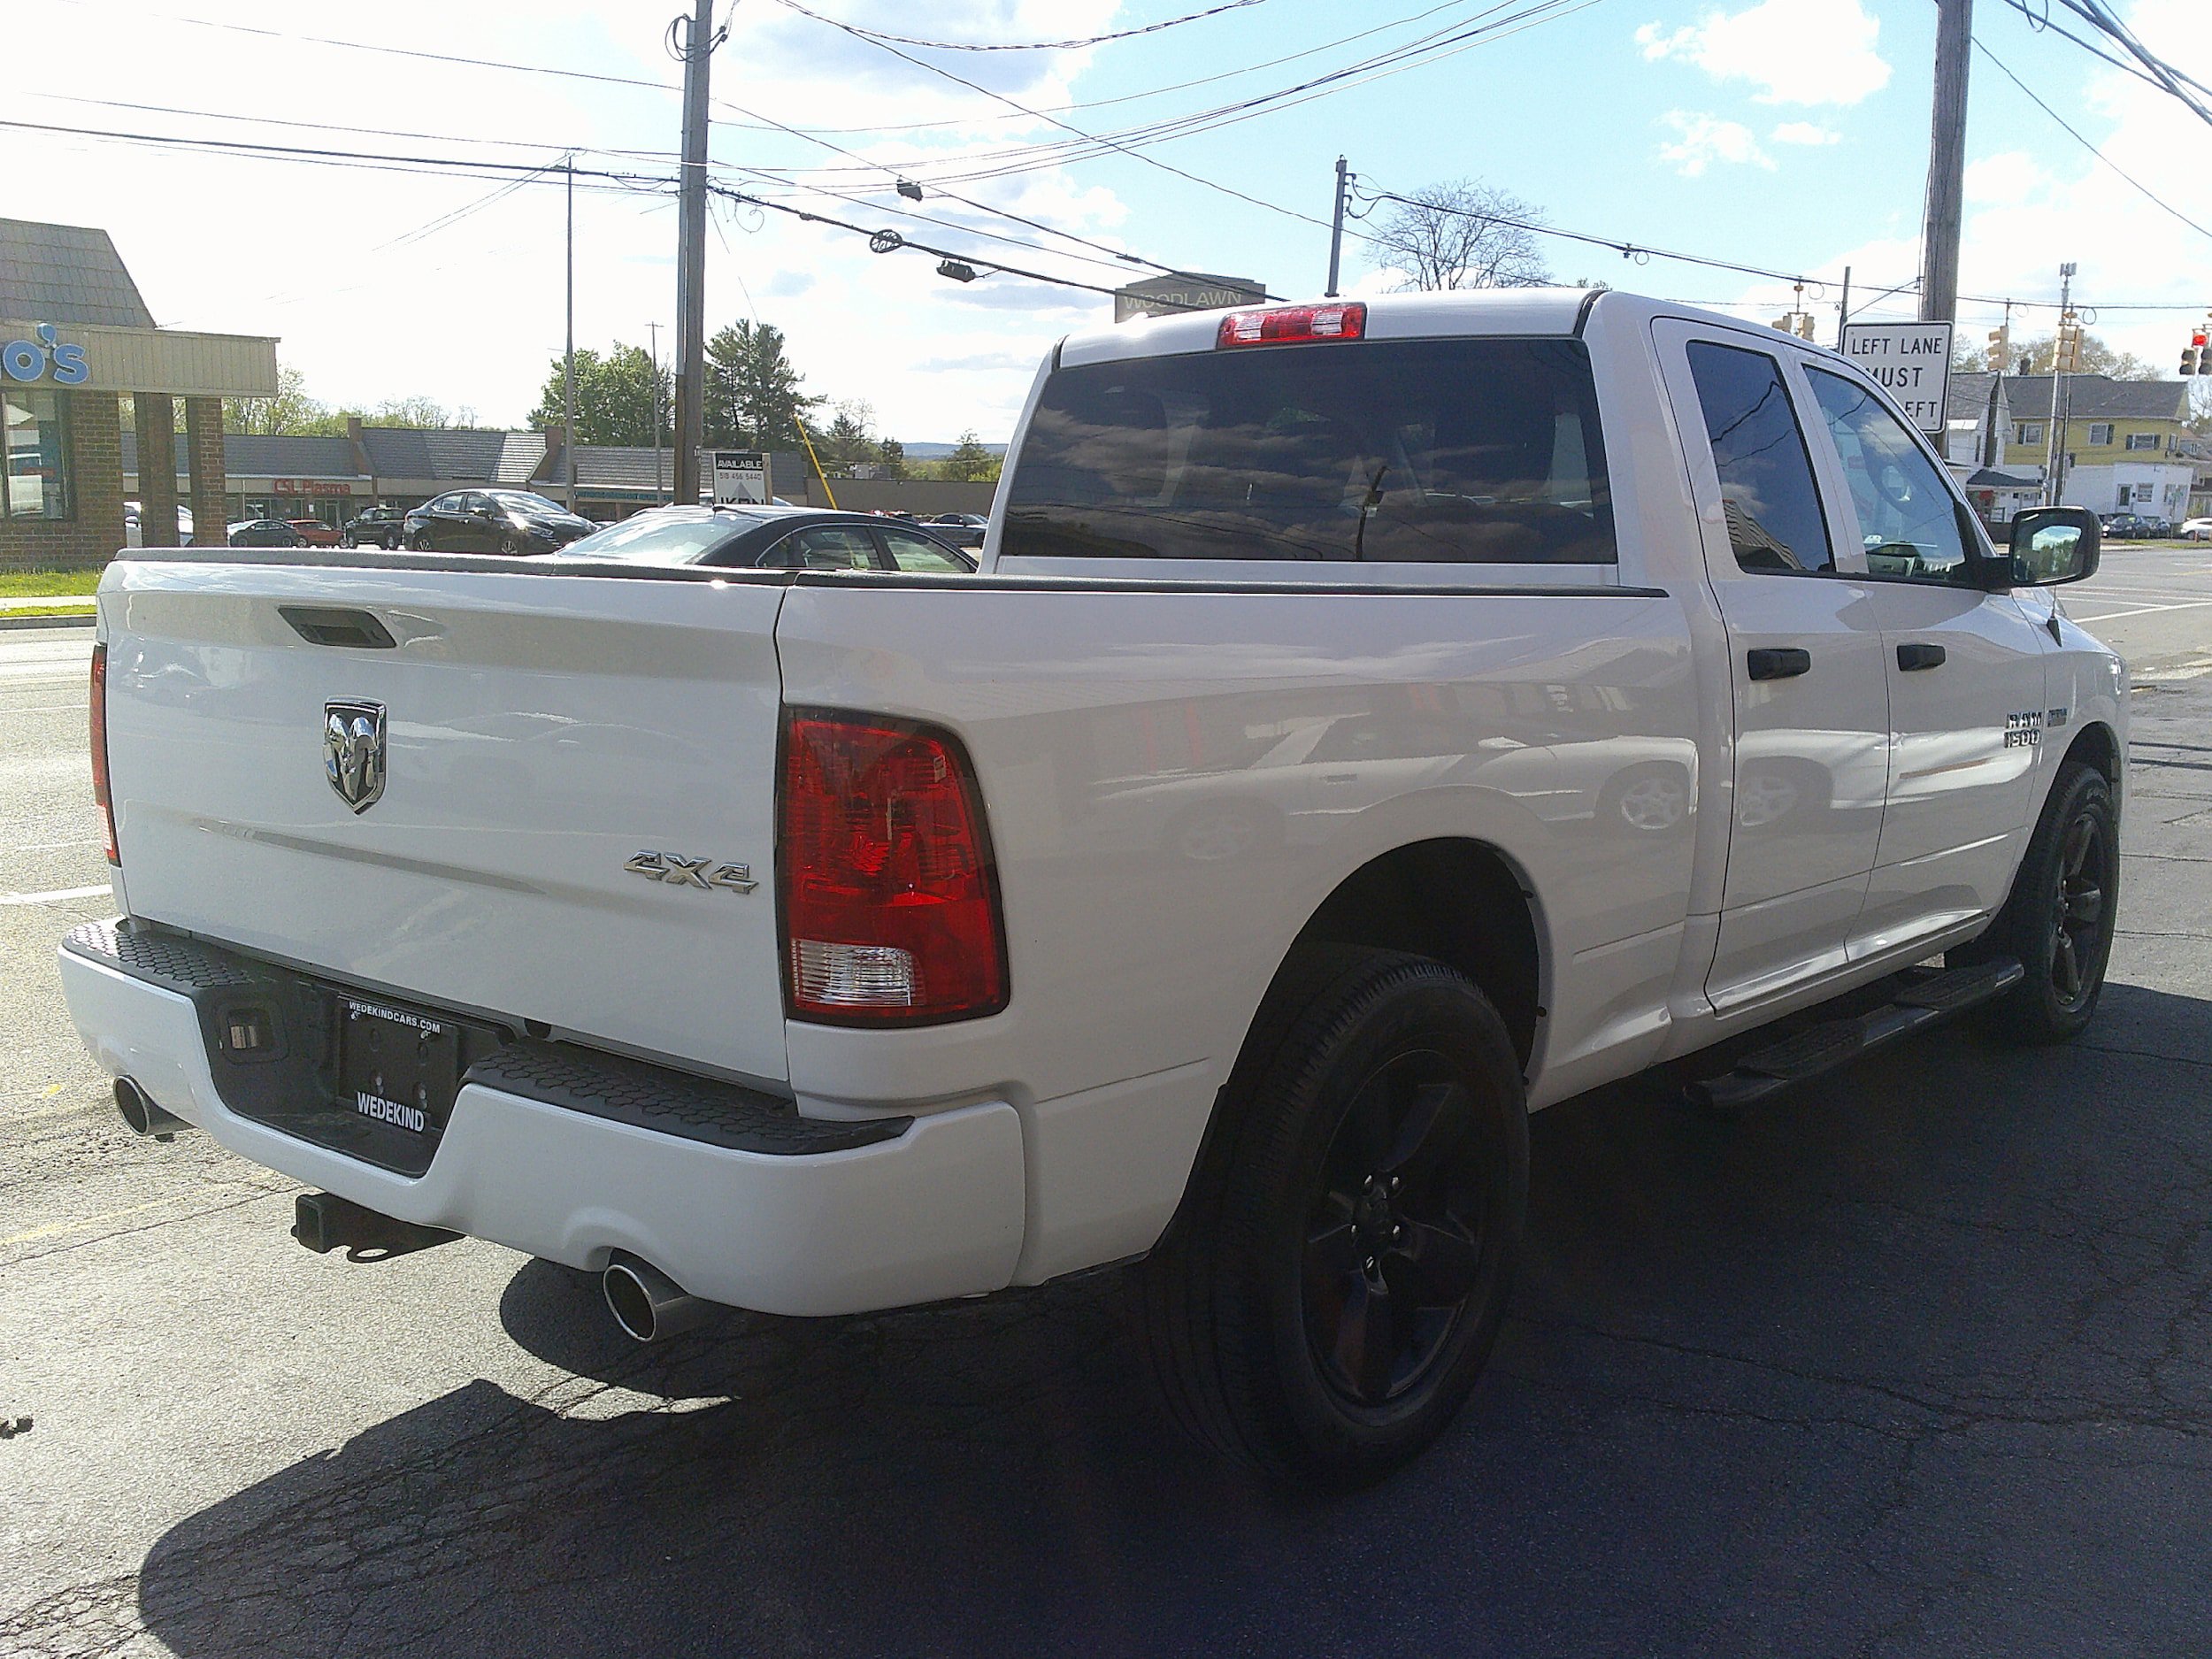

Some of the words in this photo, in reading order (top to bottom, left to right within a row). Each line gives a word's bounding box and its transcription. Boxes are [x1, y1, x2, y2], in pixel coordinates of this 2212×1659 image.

[1123, 290, 1241, 310] WOODLAWN
[0, 323, 89, 384] o's
[1852, 338, 1891, 354] LEFT
[1901, 337, 1943, 354] LANE
[1904, 401, 1938, 419] EFT
[717, 460, 763, 469] AVAILABLE
[302, 479, 351, 495] Plasma
[2006, 711, 2042, 729] RAM
[2003, 728, 2041, 749] 1500
[349, 1001, 441, 1034] WEDEKINDCARS.COM
[357, 1091, 425, 1133] WEDEKIND
